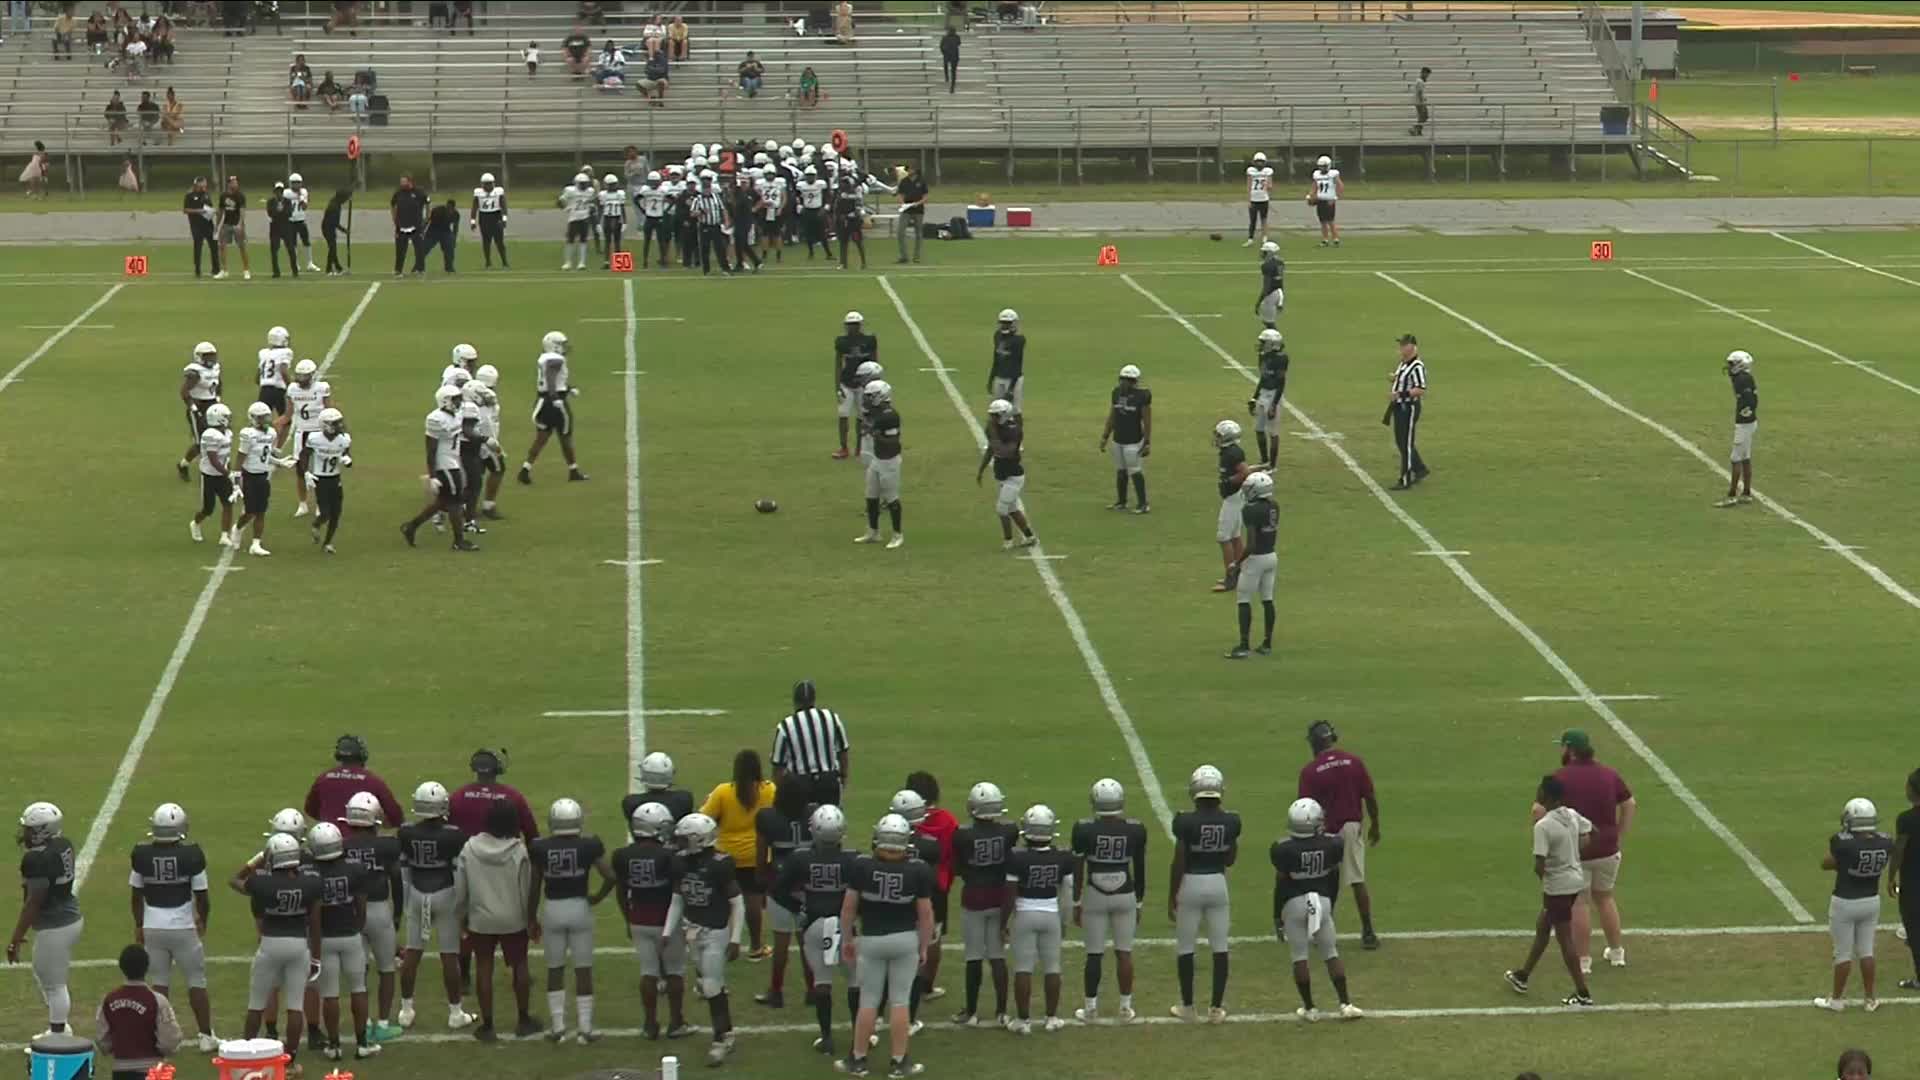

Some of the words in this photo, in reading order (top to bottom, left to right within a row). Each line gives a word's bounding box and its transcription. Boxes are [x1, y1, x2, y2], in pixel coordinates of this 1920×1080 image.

[614, 255, 631, 270] 50
[1594, 244, 1609, 258] 30
[128, 258, 144, 274] 40
[300, 404, 310, 421] 6
[321, 456, 338, 473] 19
[1096, 835, 1127, 861] 28
[1200, 825, 1225, 849] 21
[411, 839, 438, 865] 12
[974, 836, 1005, 866] 20
[1301, 851, 1324, 874] 41
[1858, 849, 1887, 876] 26
[153, 856, 178, 881] 19
[810, 864, 841, 889] 24
[1028, 864, 1059, 889] 22
[872, 871, 904, 900] 72
